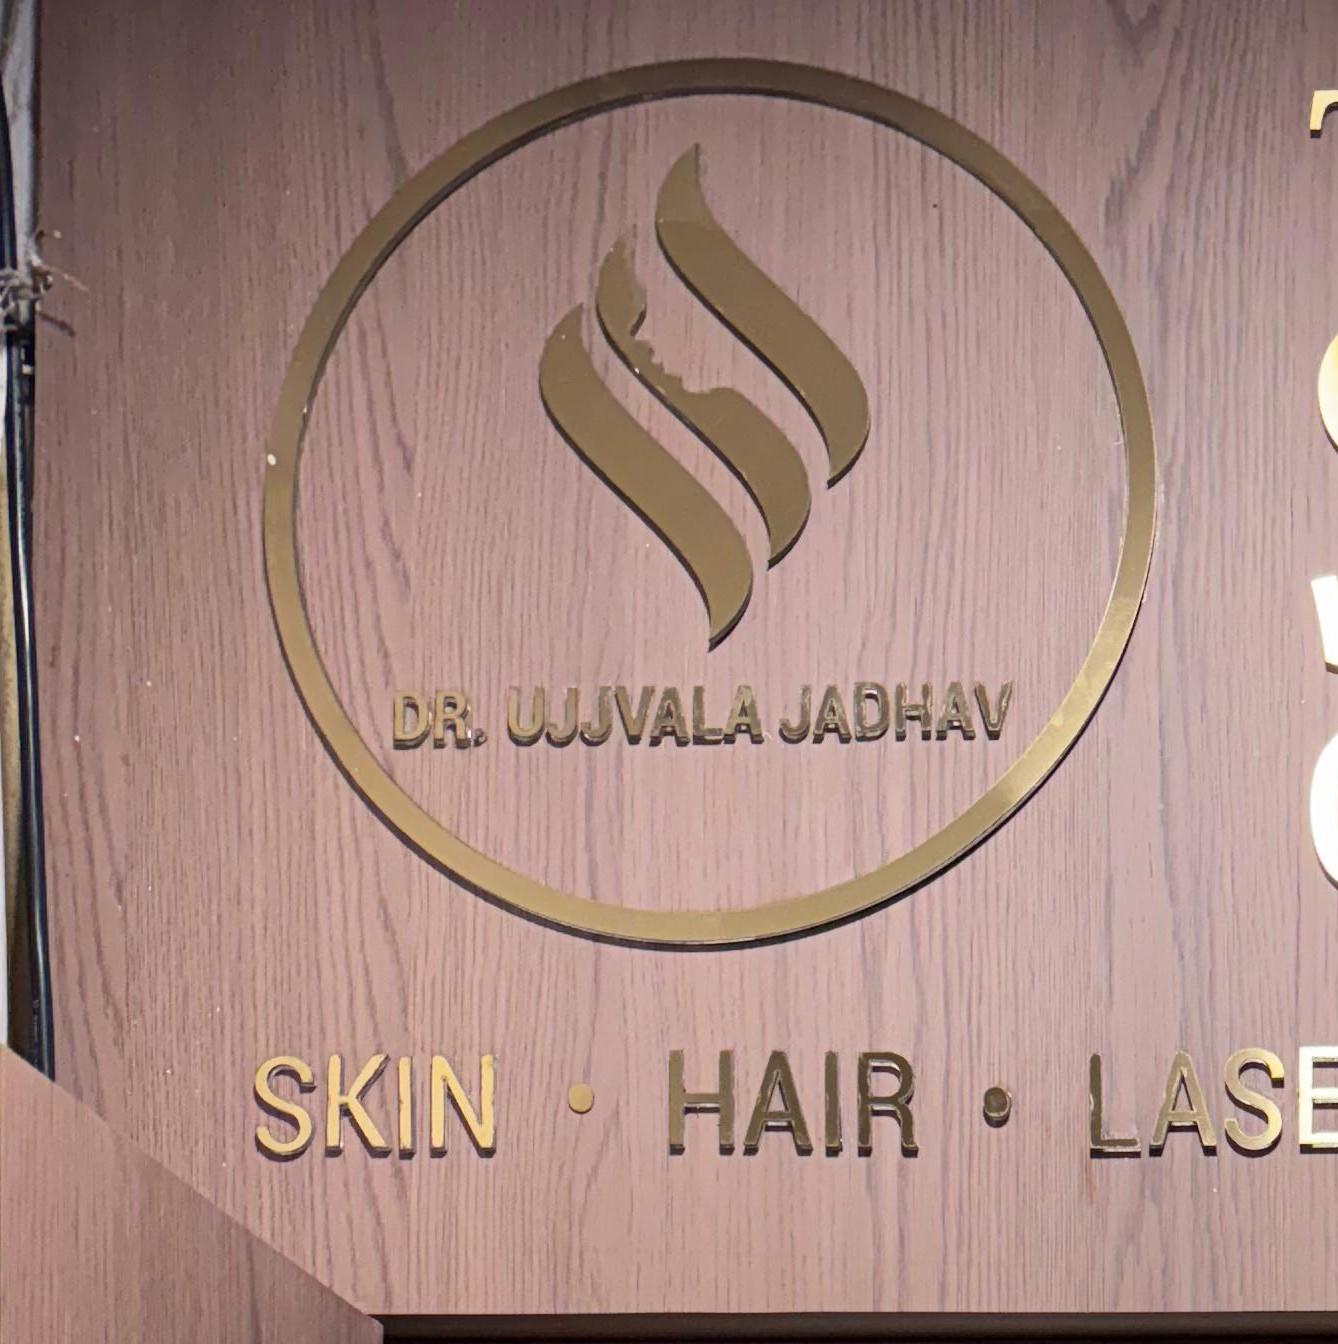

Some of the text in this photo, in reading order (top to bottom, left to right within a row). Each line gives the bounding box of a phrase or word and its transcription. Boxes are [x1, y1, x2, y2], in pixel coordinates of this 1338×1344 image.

[392, 681, 1013, 750] DR. UJJVALA JADHAV
[253, 1053, 497, 1159] SKIN
[668, 1049, 919, 1158] HAIR
